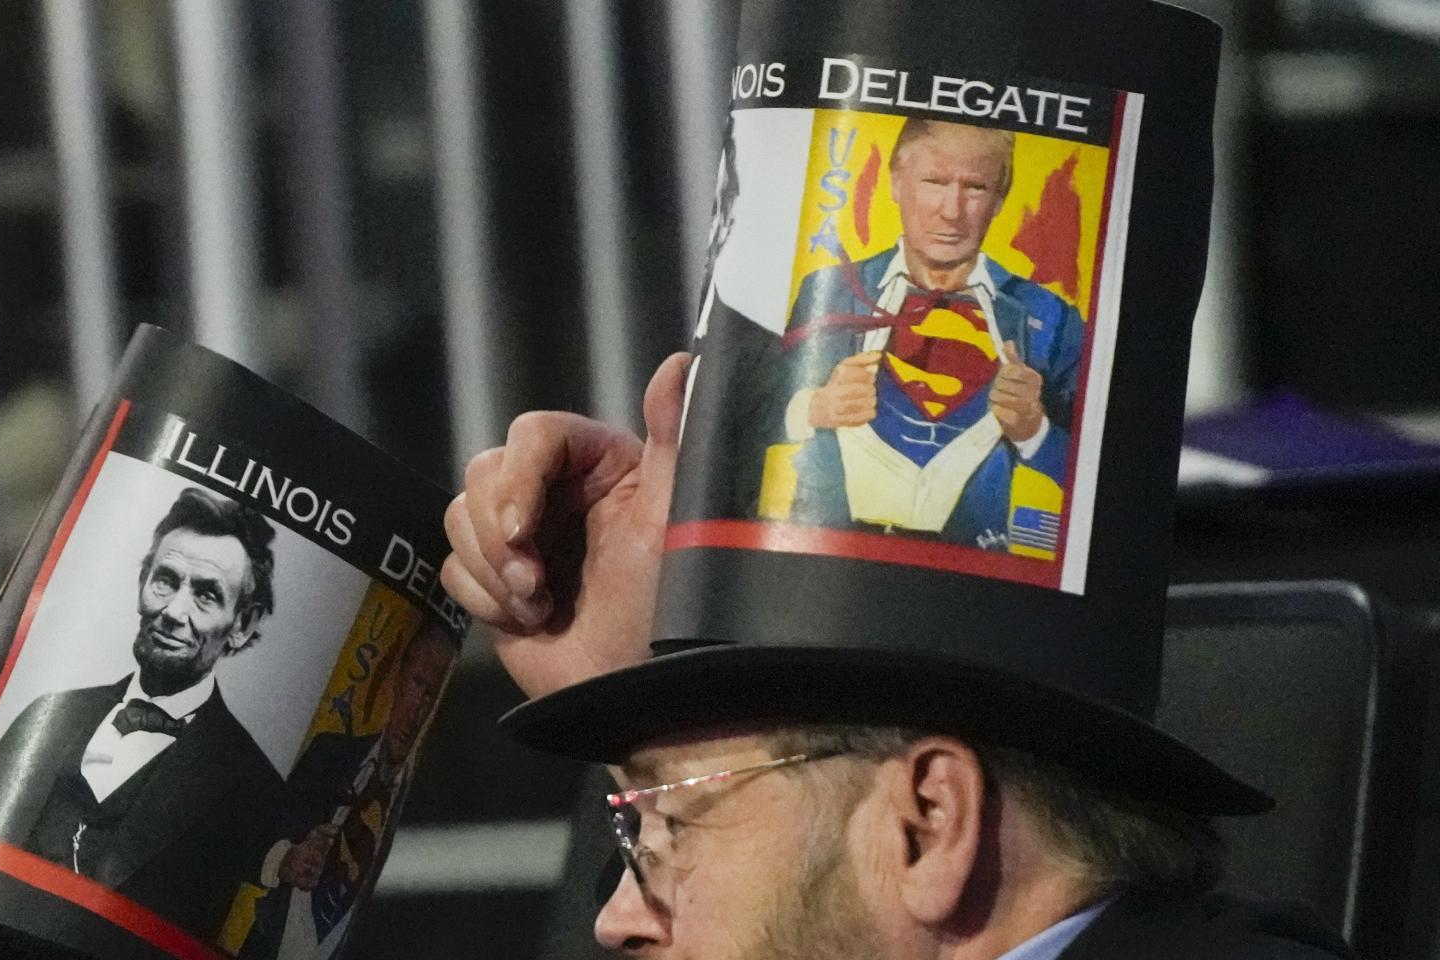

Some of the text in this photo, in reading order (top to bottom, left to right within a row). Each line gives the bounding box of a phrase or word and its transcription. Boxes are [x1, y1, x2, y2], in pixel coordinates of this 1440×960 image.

[818, 57, 1091, 134] DELEGATE
[810, 127, 858, 257] USA
[150, 412, 357, 546] ILLINOIS
